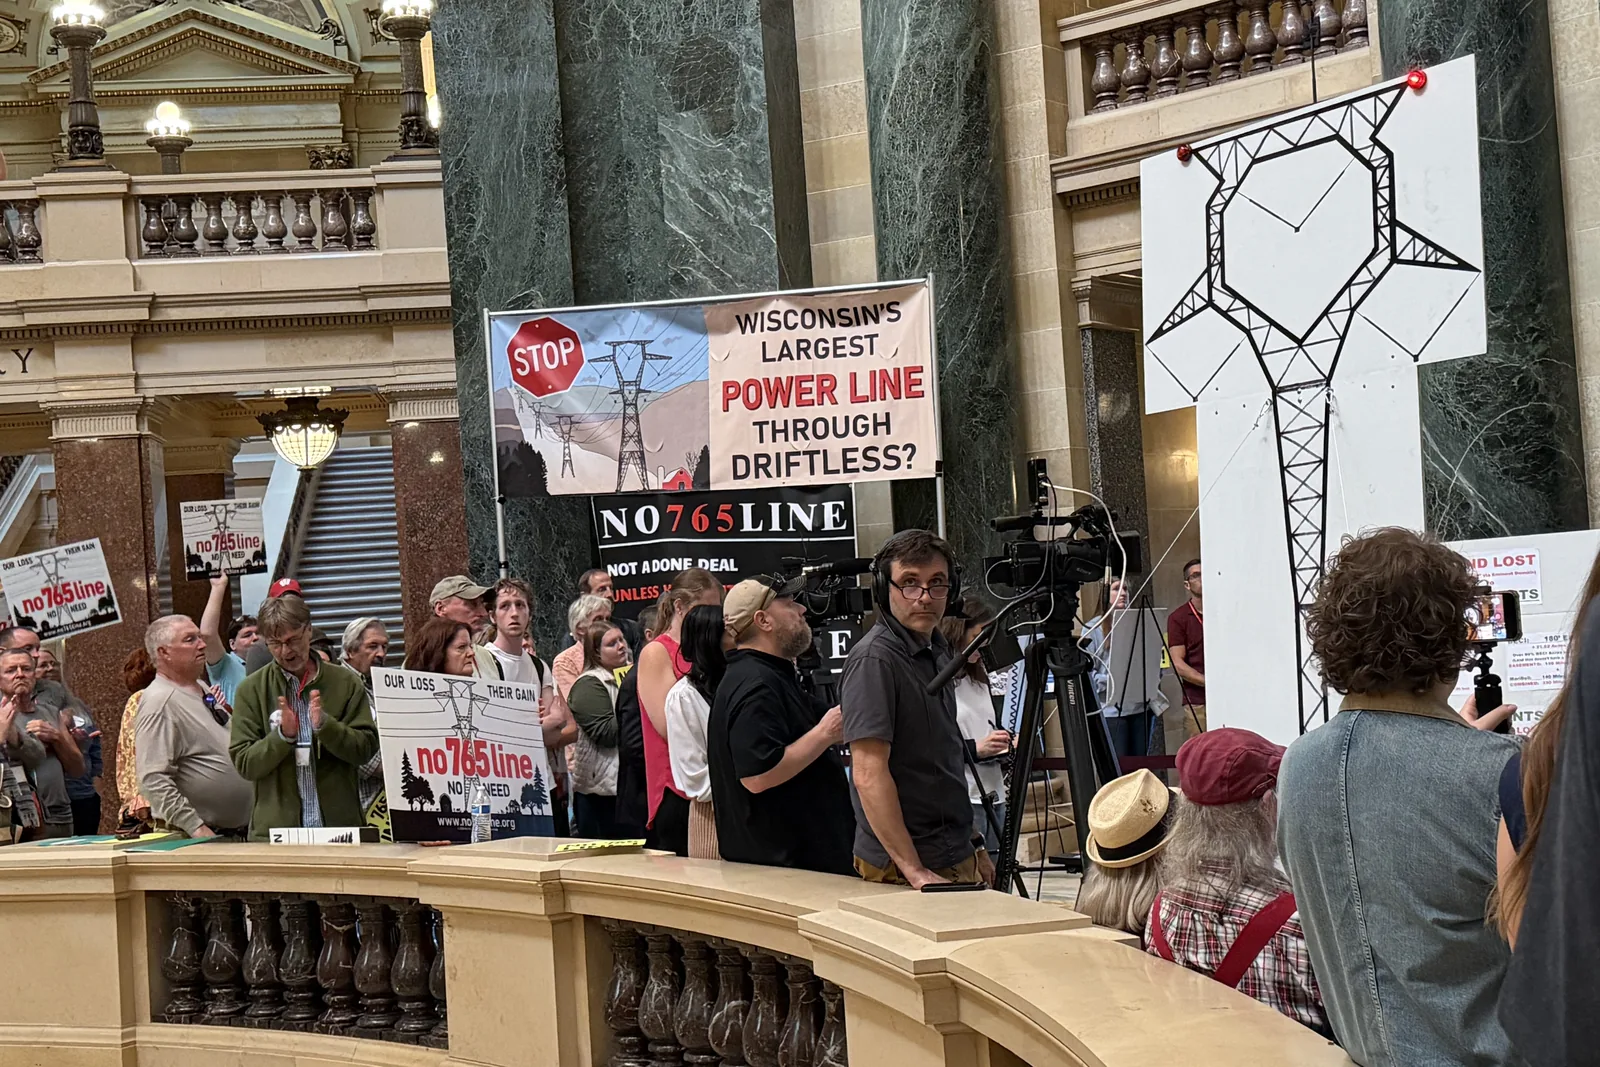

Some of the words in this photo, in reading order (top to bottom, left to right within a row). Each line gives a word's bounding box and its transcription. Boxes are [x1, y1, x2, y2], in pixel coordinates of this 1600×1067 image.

[735, 301, 901, 335] WISCONSIN'S
[513, 336, 575, 377] STOP
[761, 333, 879, 363] LARGEST
[722, 373, 837, 412] POWER
[850, 365, 925, 404] LINE
[752, 411, 892, 444] THROUGH
[732, 443, 917, 481] DRIFTLESS?
[607, 562, 638, 577] NOT
[697, 558, 739, 573] DEAL
[1493, 554, 1536, 568] LOST
[384, 674, 405, 689] OUR
[410, 676, 436, 692] LOSS
[487, 684, 514, 700] THEIR
[515, 687, 536, 702] GAIN
[447, 781, 463, 795] NO
[482, 782, 510, 797] NEED
